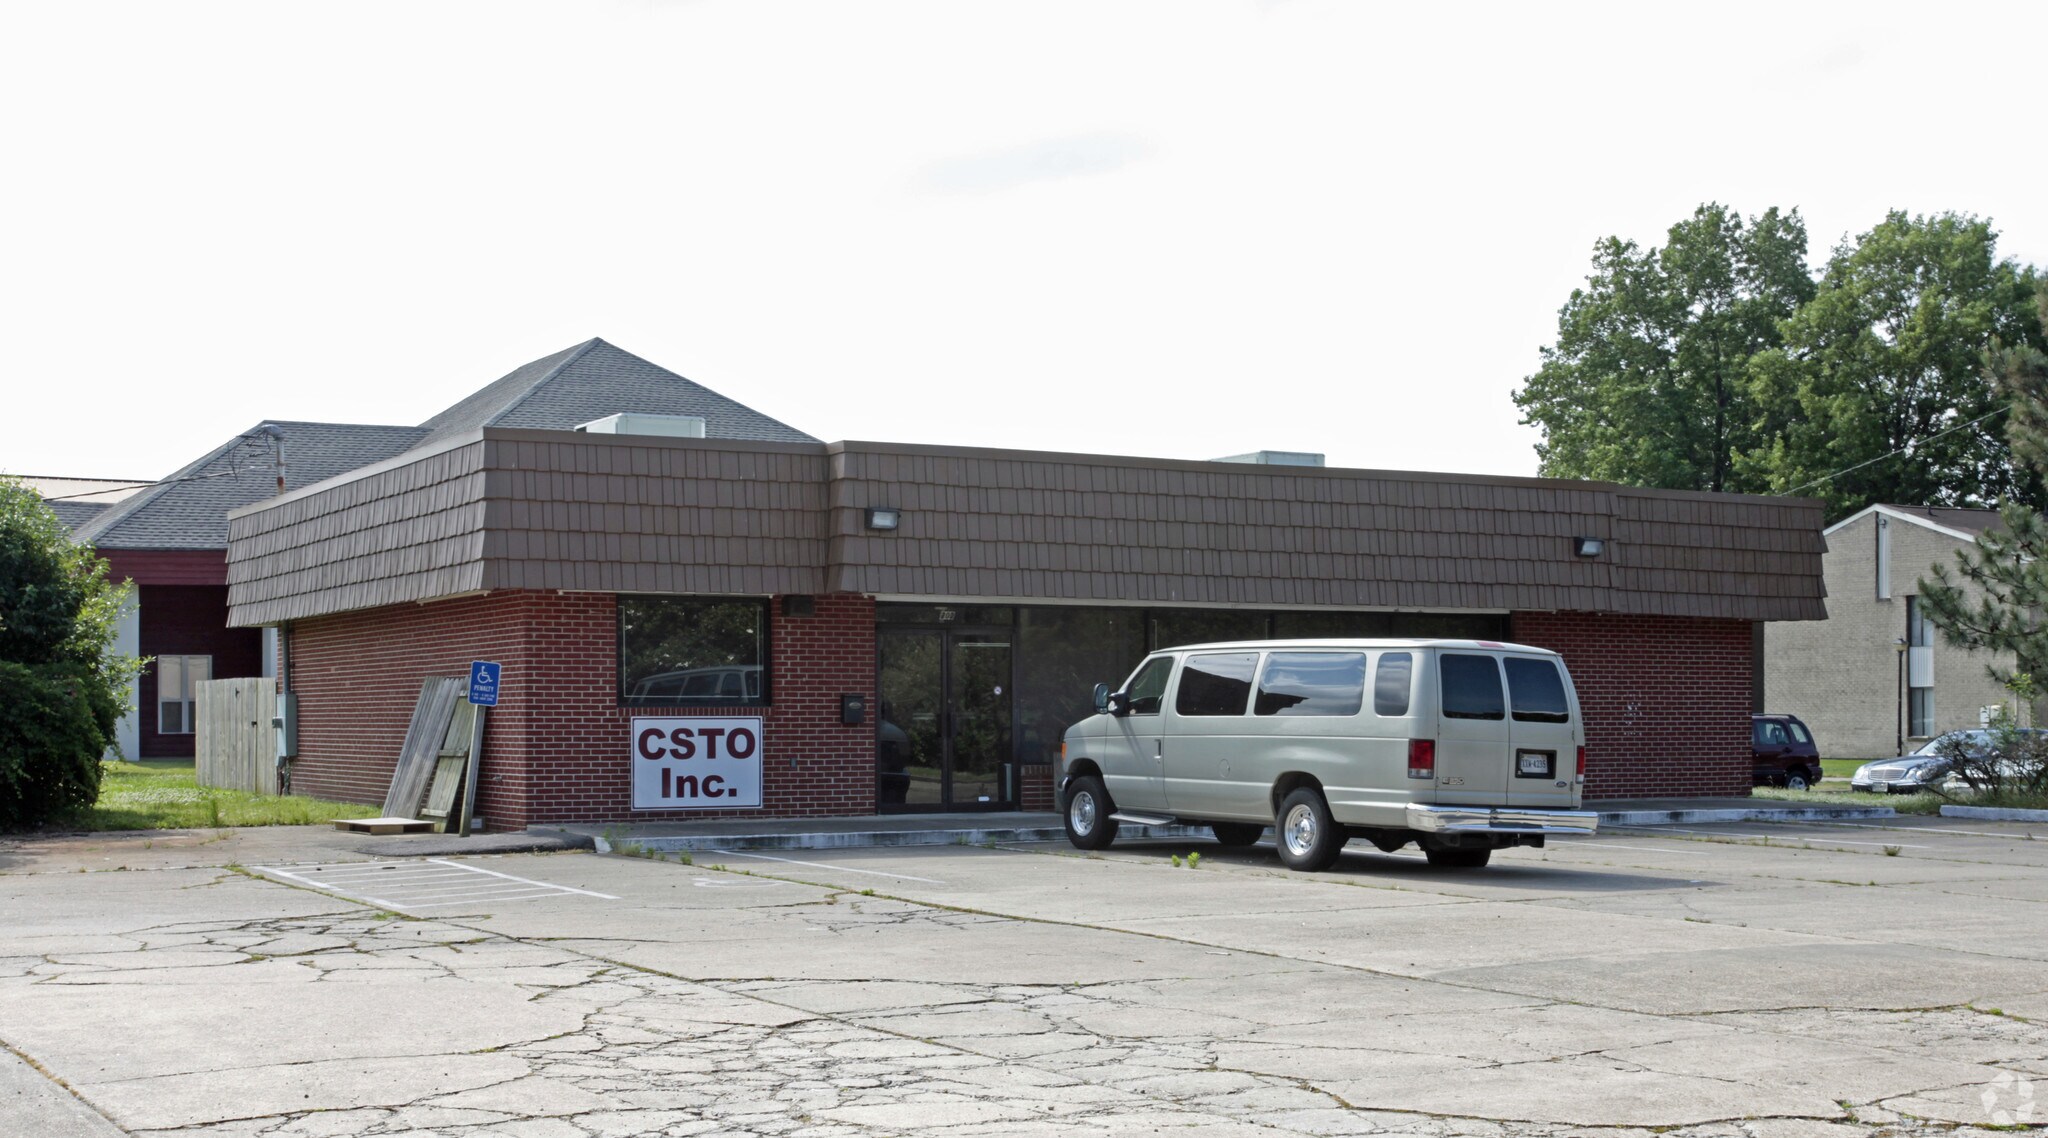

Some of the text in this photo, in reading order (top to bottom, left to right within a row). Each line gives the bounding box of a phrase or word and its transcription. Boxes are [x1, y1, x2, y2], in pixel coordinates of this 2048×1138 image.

[473, 684, 494, 693] PENALTY
[638, 727, 756, 760] CSTO
[661, 767, 737, 798] Inc.
